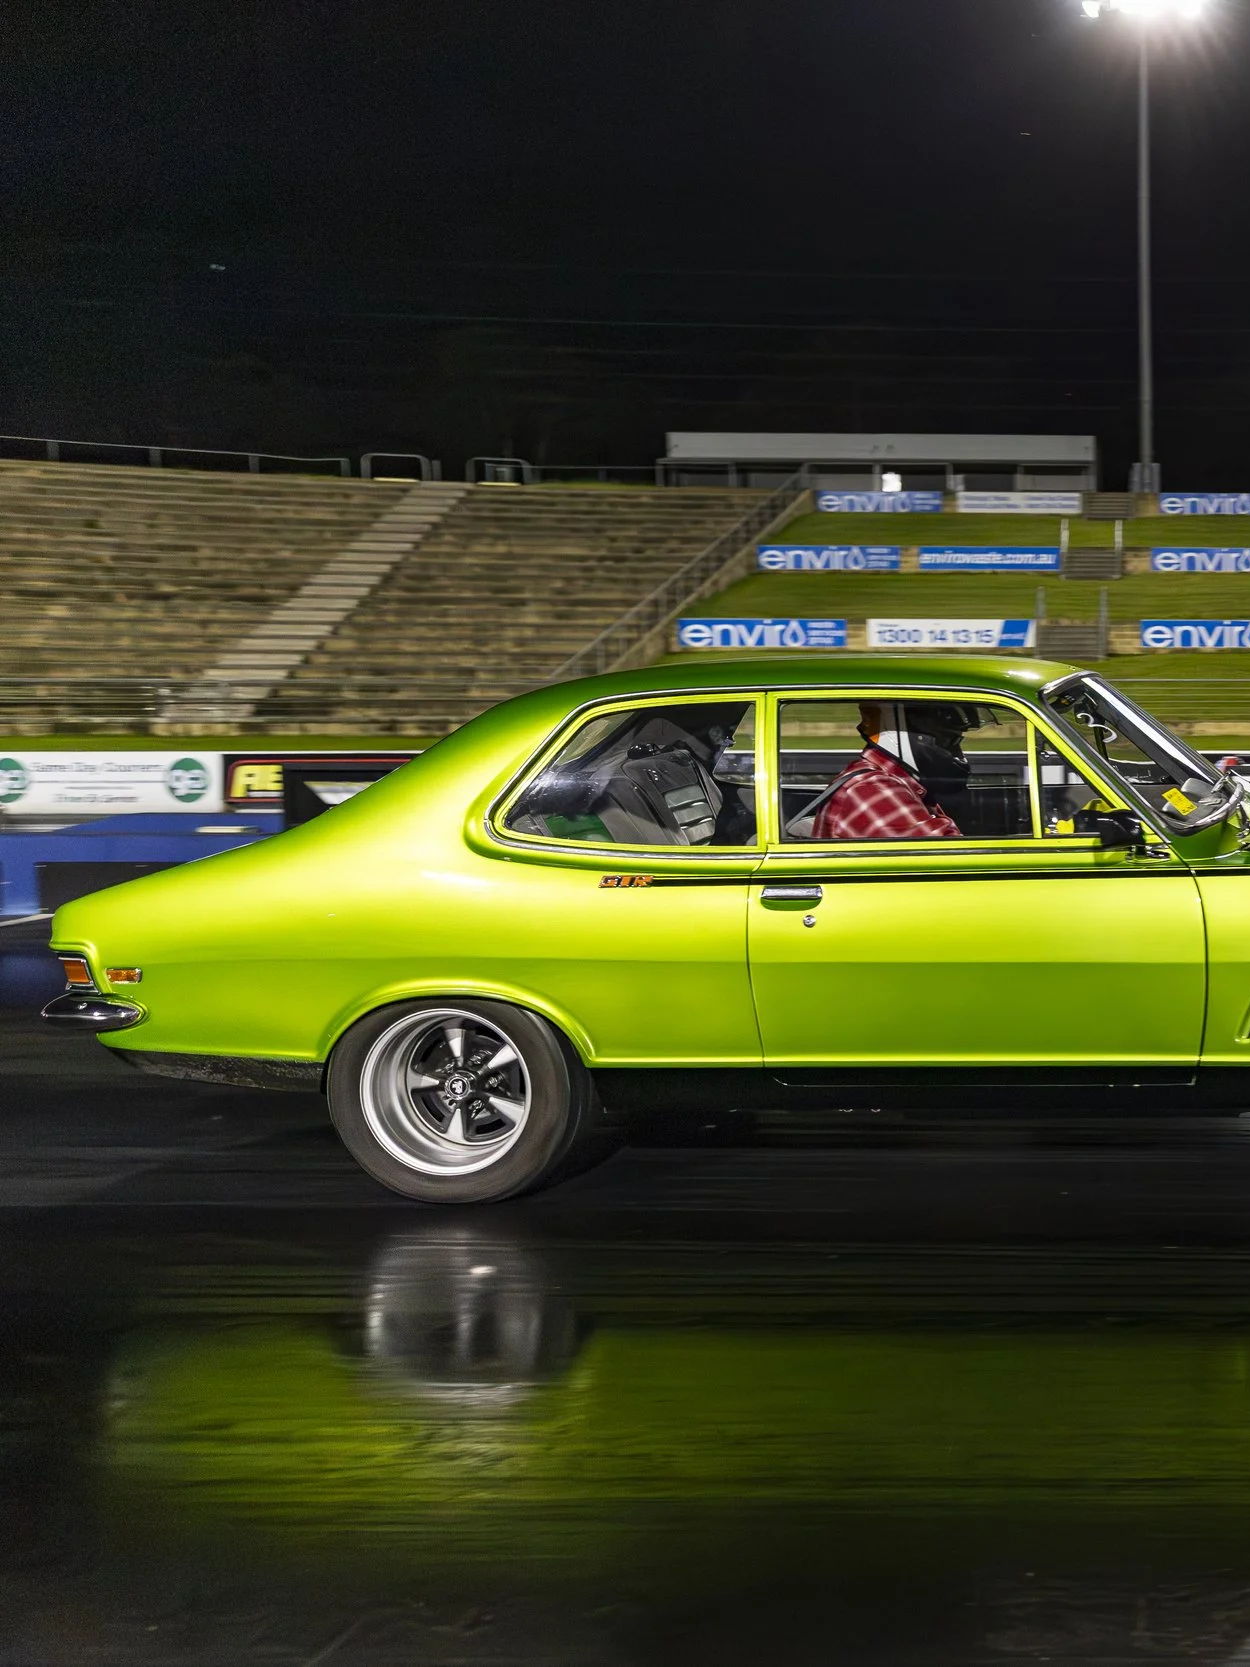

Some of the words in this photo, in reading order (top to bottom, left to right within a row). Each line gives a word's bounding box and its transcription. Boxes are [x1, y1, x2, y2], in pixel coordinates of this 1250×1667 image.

[877, 629, 923, 643] 1300
[928, 629, 948, 643] 14
[952, 629, 971, 643] 13
[974, 629, 995, 643] 15
